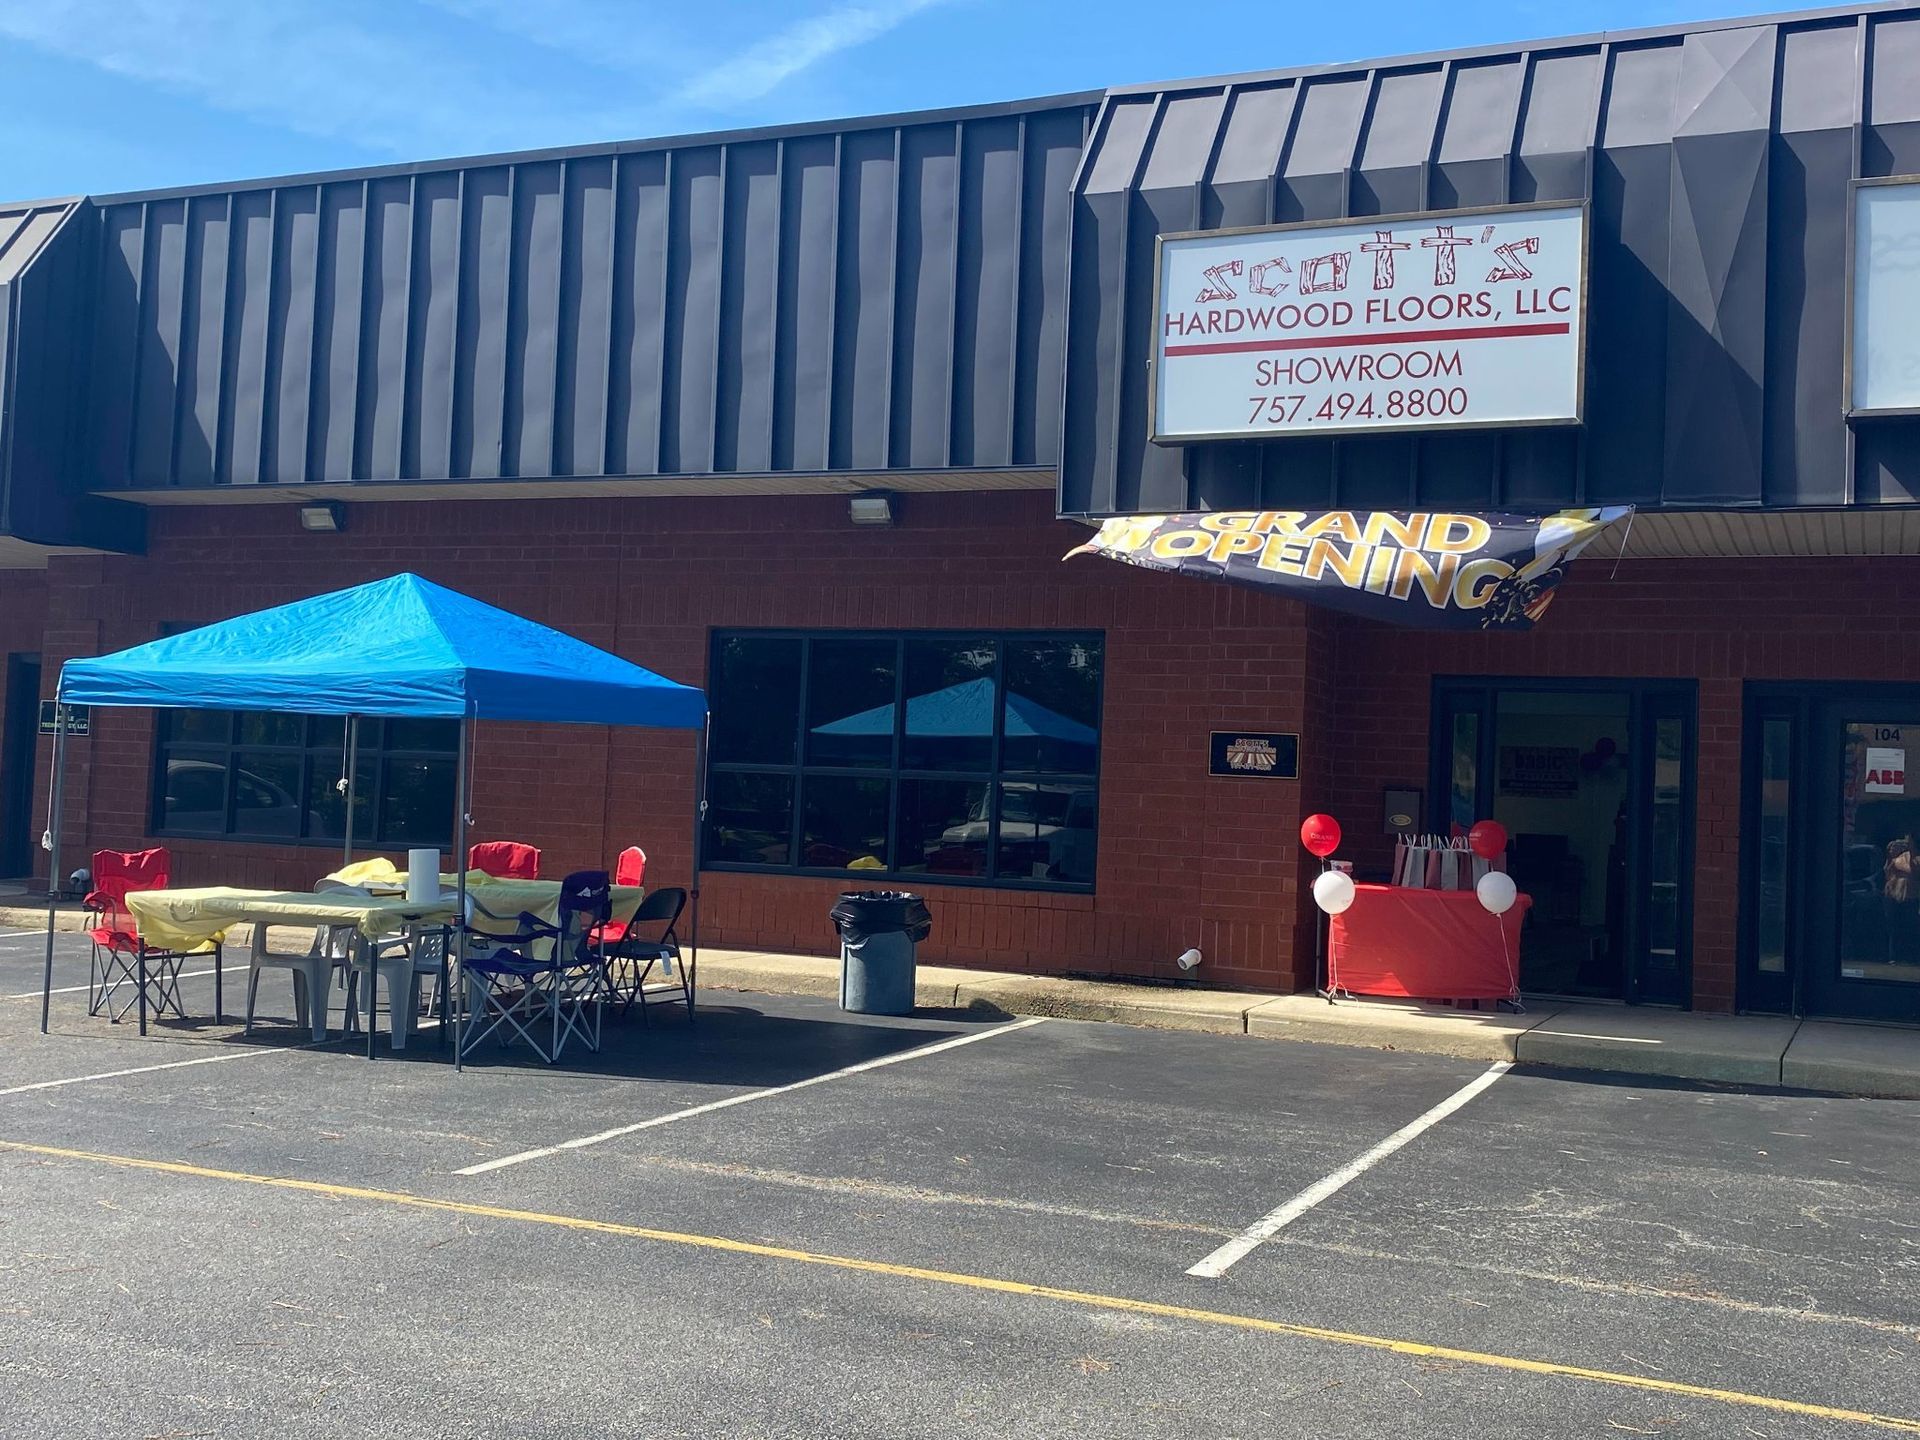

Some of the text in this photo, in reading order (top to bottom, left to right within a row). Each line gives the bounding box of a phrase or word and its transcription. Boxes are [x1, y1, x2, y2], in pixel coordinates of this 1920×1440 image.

[1165, 286, 1571, 337] HARDWOOD FLOORS, LLC
[1255, 349, 1463, 387] SHOWROOM
[1248, 387, 1468, 425] 757.494.8800
[1198, 511, 1491, 553] GRAND
[1150, 529, 1517, 610] OPENING
[1875, 728, 1900, 741] 104
[1865, 769, 1904, 785] ABB
